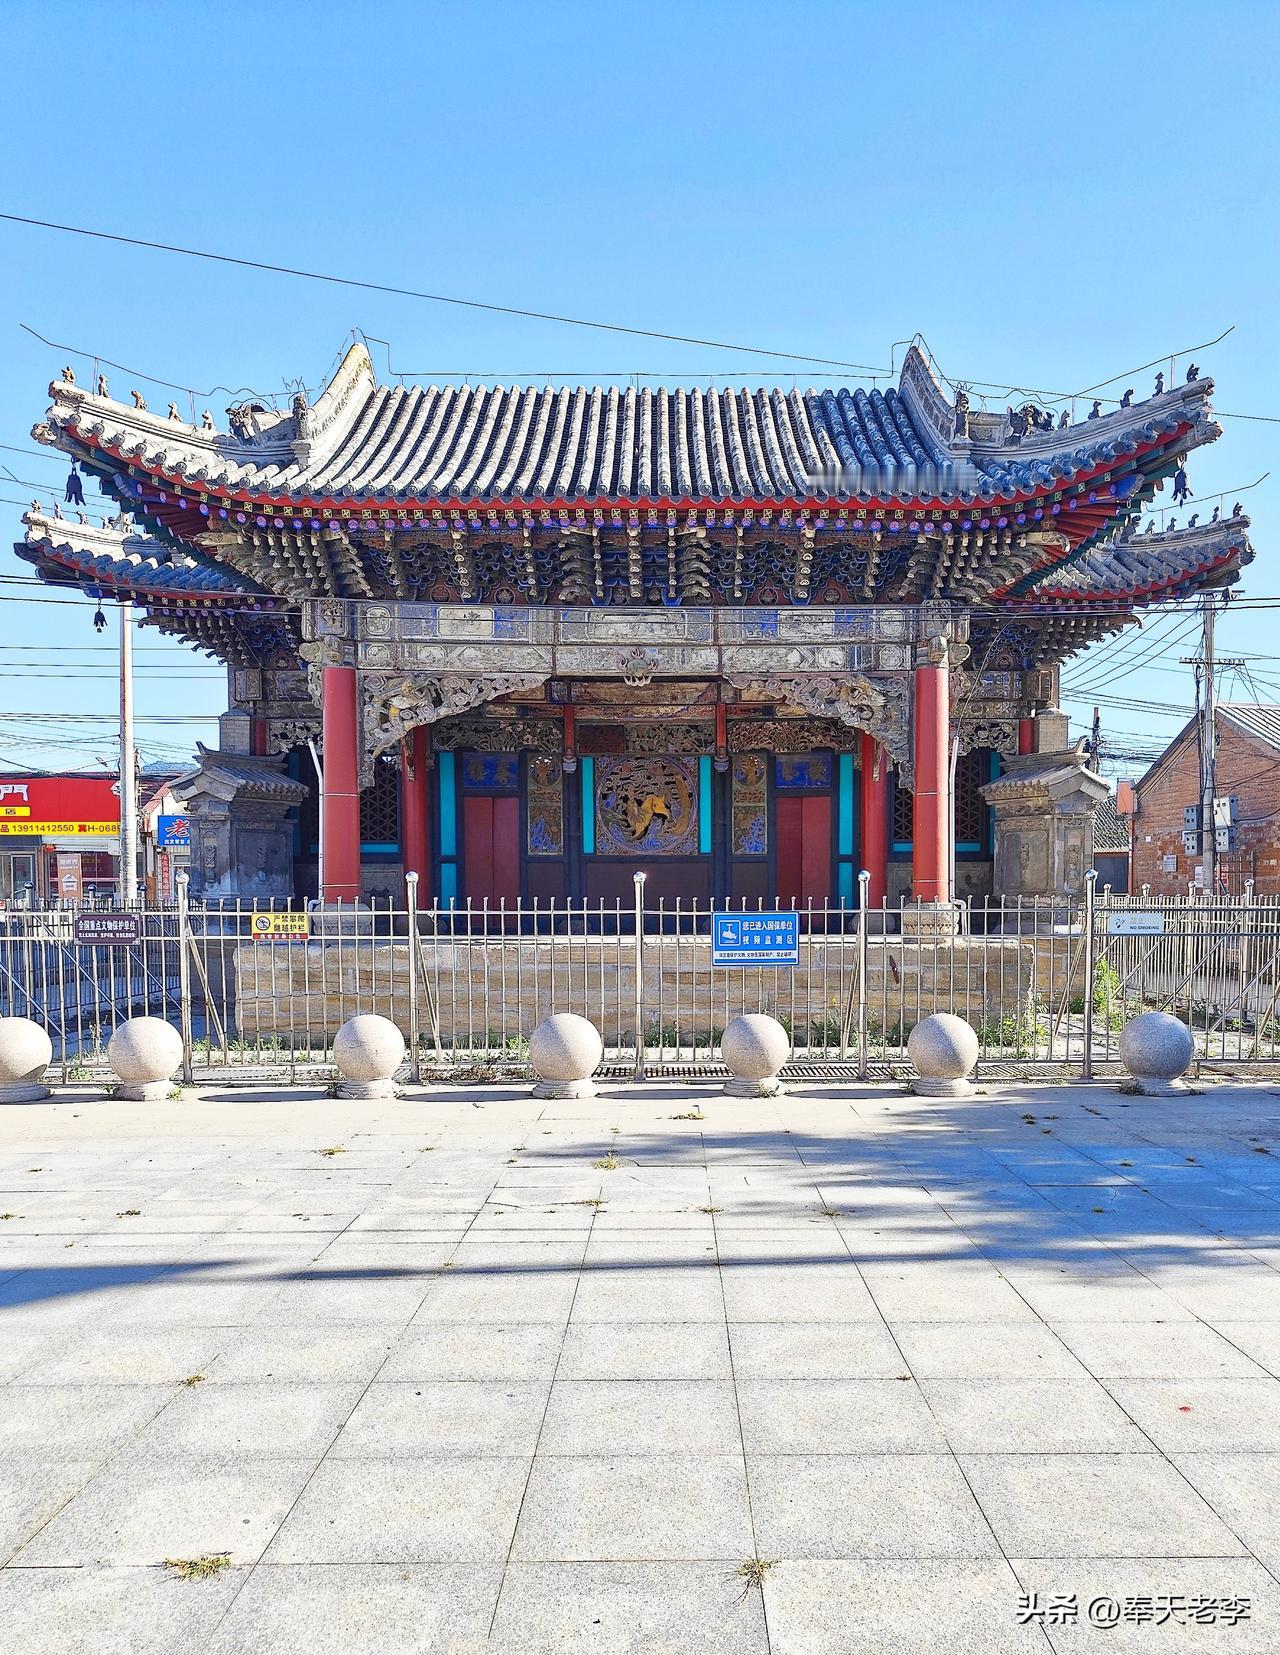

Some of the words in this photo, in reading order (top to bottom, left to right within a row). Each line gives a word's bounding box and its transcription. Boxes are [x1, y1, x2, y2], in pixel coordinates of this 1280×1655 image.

[12, 824, 74, 833] 13911412550
[165, 818, 190, 838] 老
[78, 920, 136, 931] 全国重点文物保护单位
[742, 921, 793, 931] 您已进入国保单位
